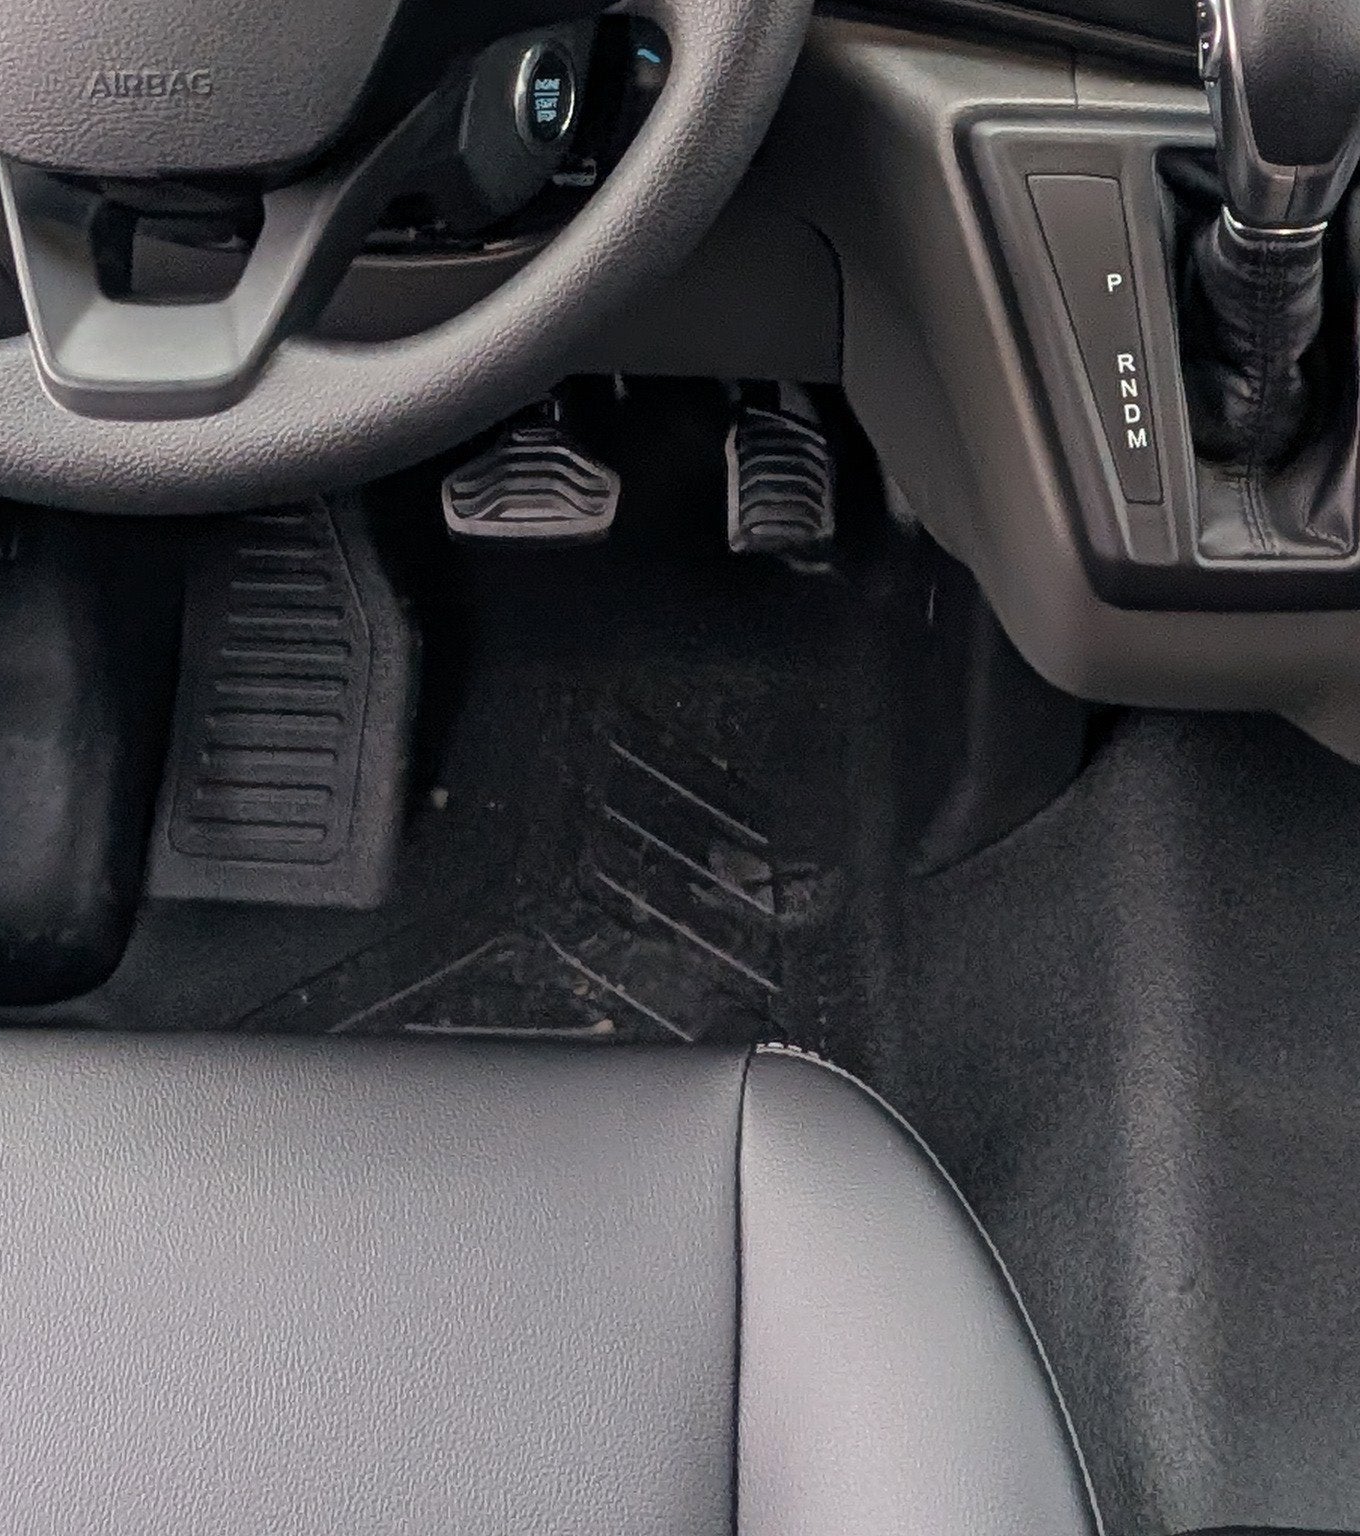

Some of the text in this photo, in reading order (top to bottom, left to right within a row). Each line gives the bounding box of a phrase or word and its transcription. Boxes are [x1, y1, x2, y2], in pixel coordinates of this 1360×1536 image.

[89, 69, 214, 99] AIRBAG
[1106, 273, 1123, 292] P
[1117, 353, 1136, 373] R
[1120, 379, 1139, 398] N
[1124, 403, 1141, 424] D
[1127, 429, 1148, 449] M
